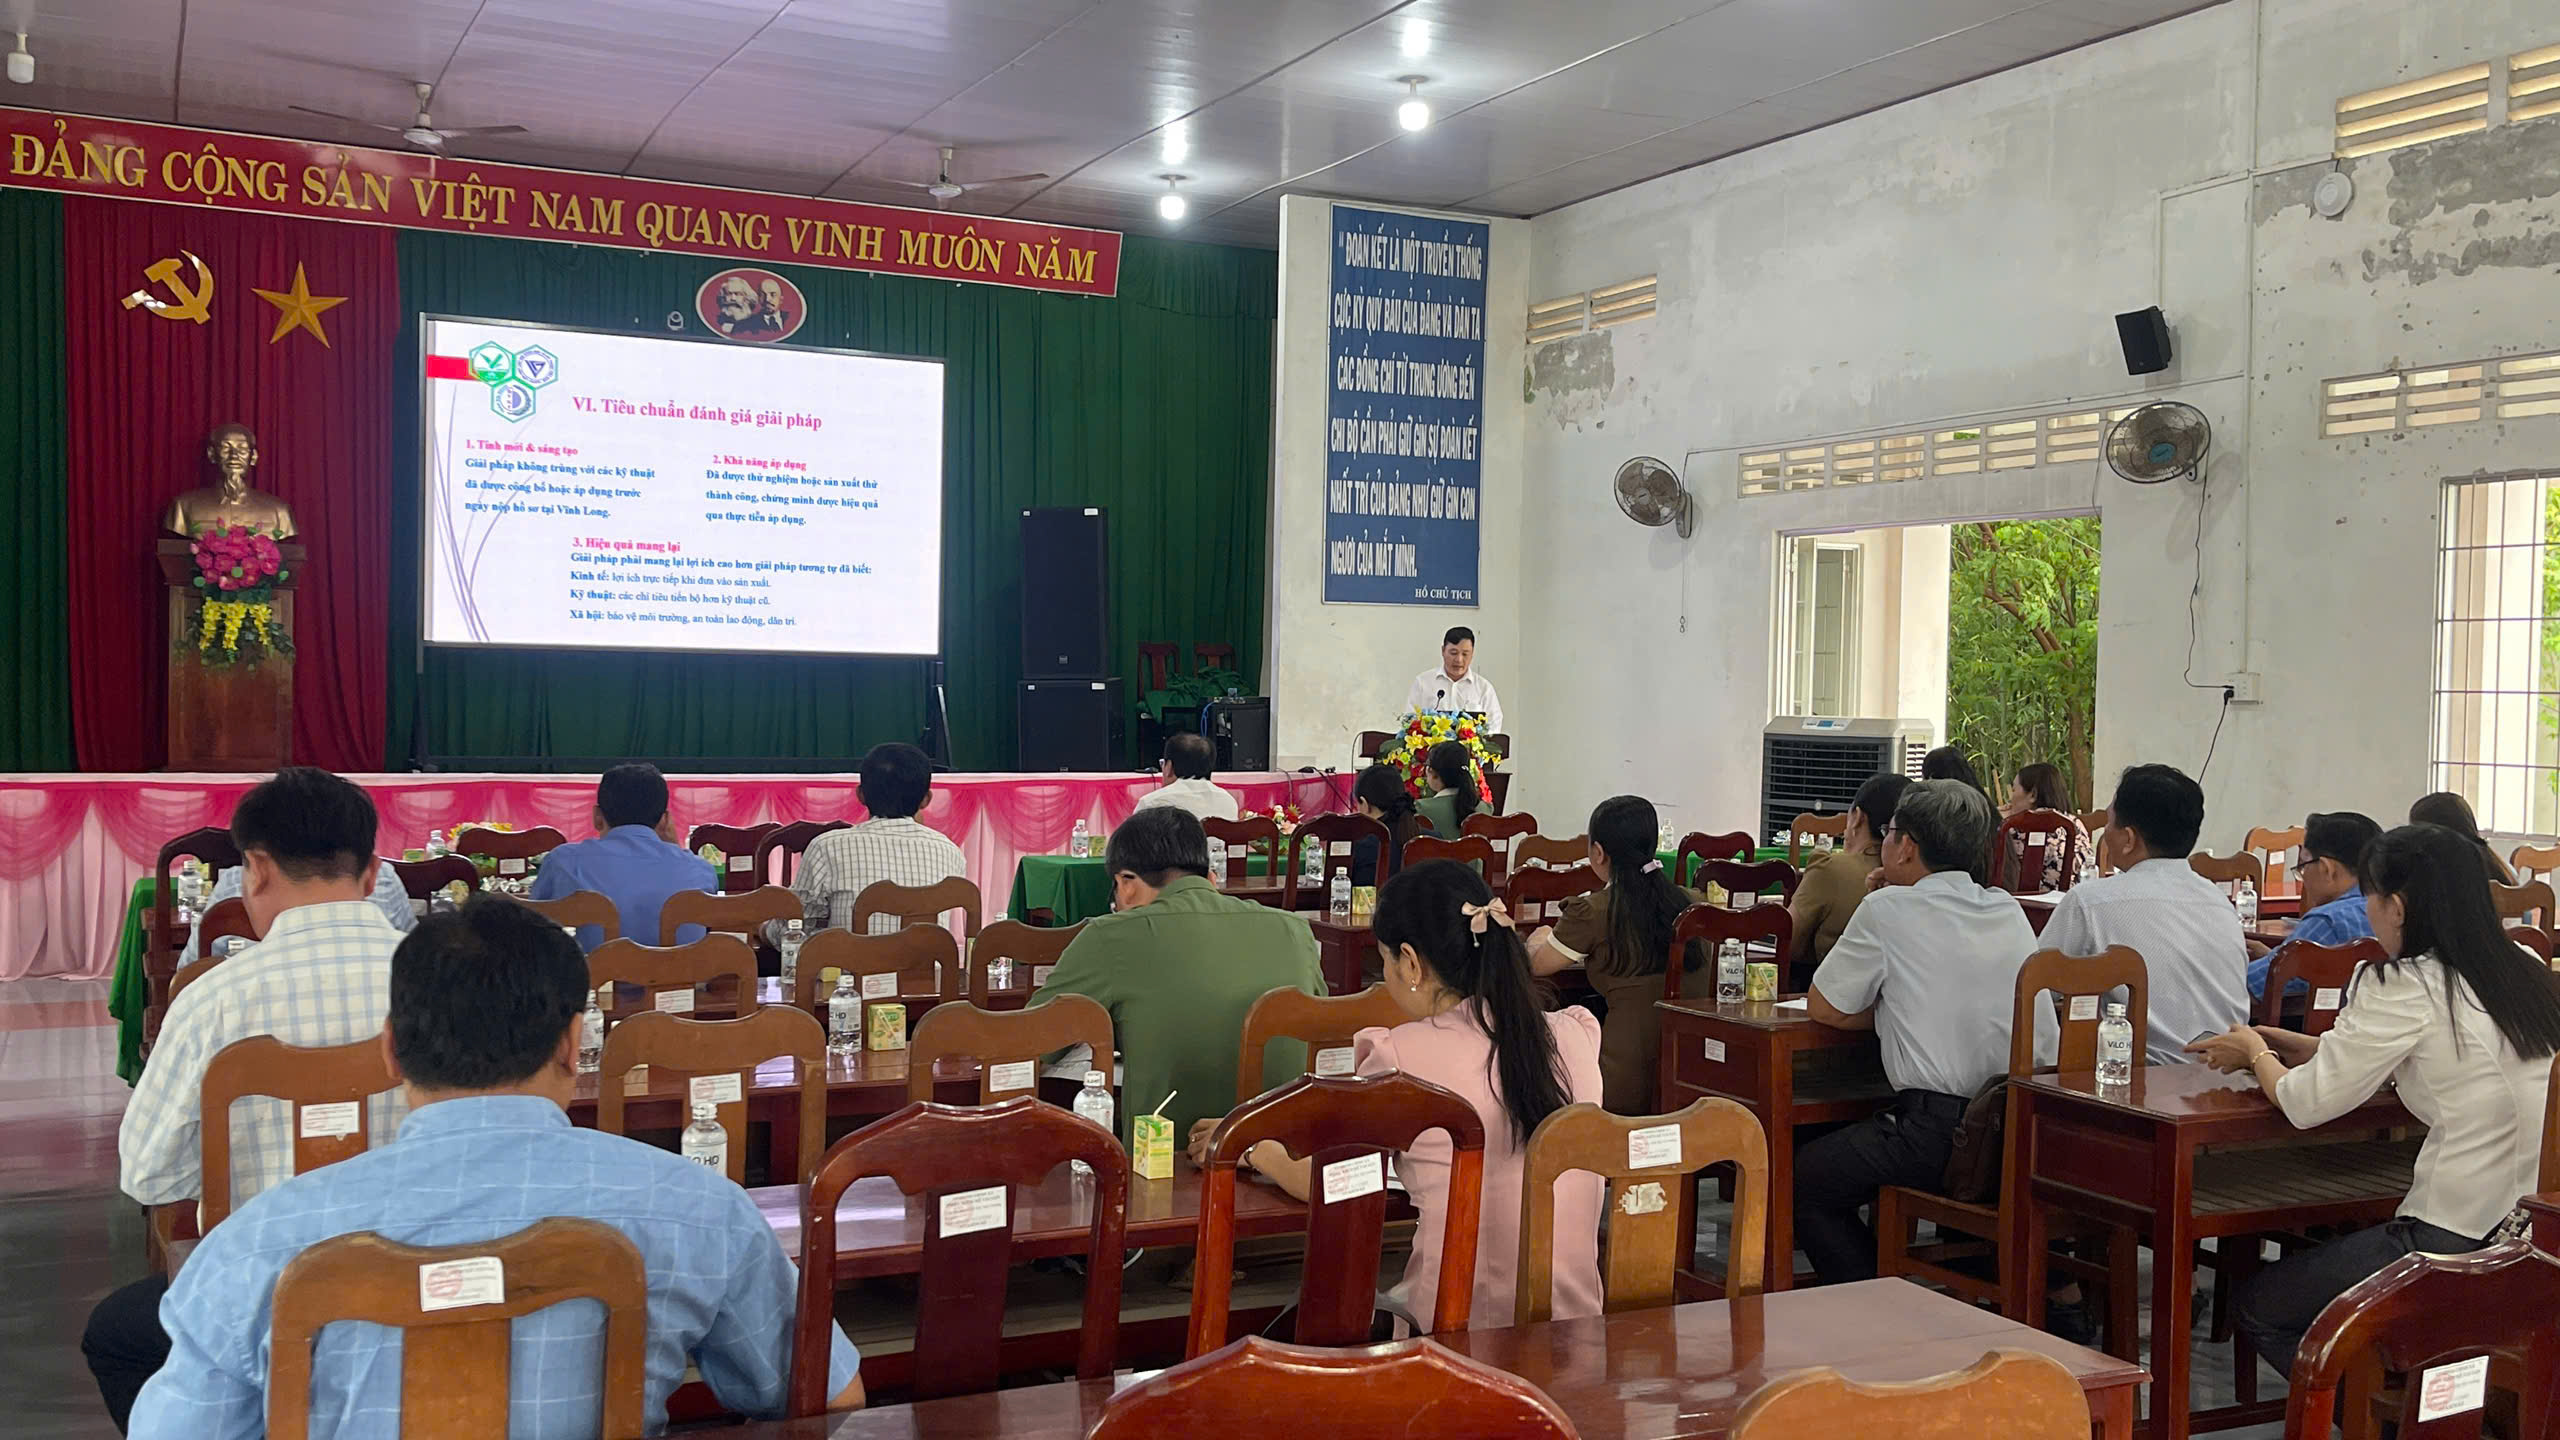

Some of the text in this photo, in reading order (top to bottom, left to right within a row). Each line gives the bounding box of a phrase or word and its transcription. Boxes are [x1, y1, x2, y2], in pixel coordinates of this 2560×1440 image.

[10, 120, 1097, 283] ĐẢNG CỘNG SẢN VIỆT NAM QUANG VINH MUÔN NĂM
[573, 397, 822, 431] VI. Tiêu chuẩn đánh giá giải pháp
